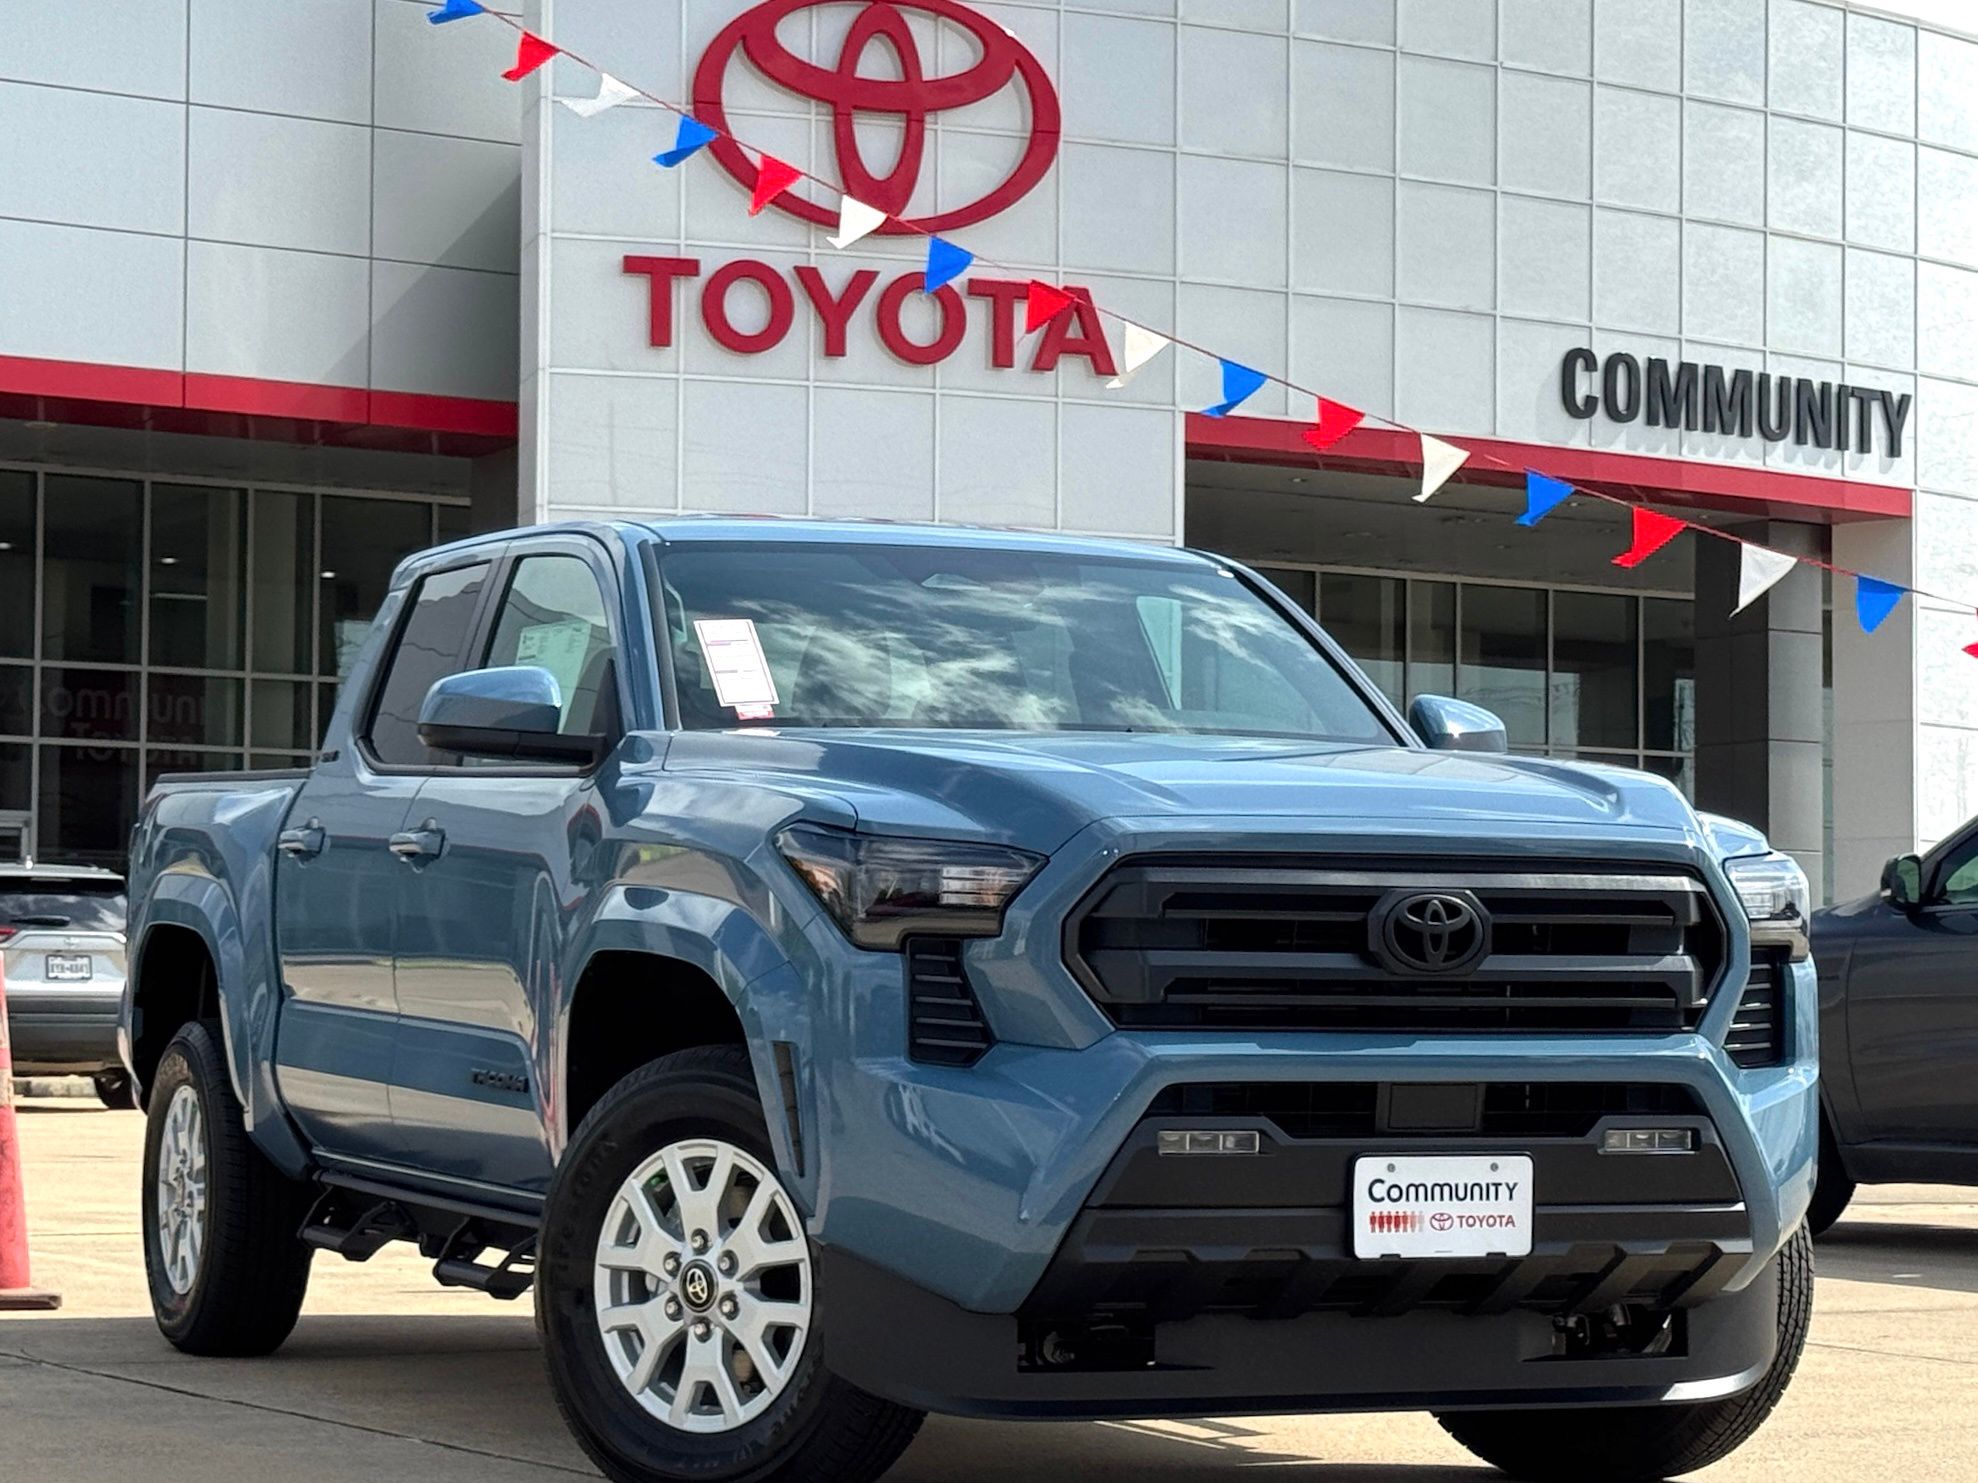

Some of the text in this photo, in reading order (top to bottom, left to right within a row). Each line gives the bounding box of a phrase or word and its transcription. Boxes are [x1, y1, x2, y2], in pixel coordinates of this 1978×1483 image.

[622, 254, 1119, 376] TOYOTA
[1561, 346, 1913, 459] COMMUNITY
[1456, 1214, 1516, 1228] TOYOTA
